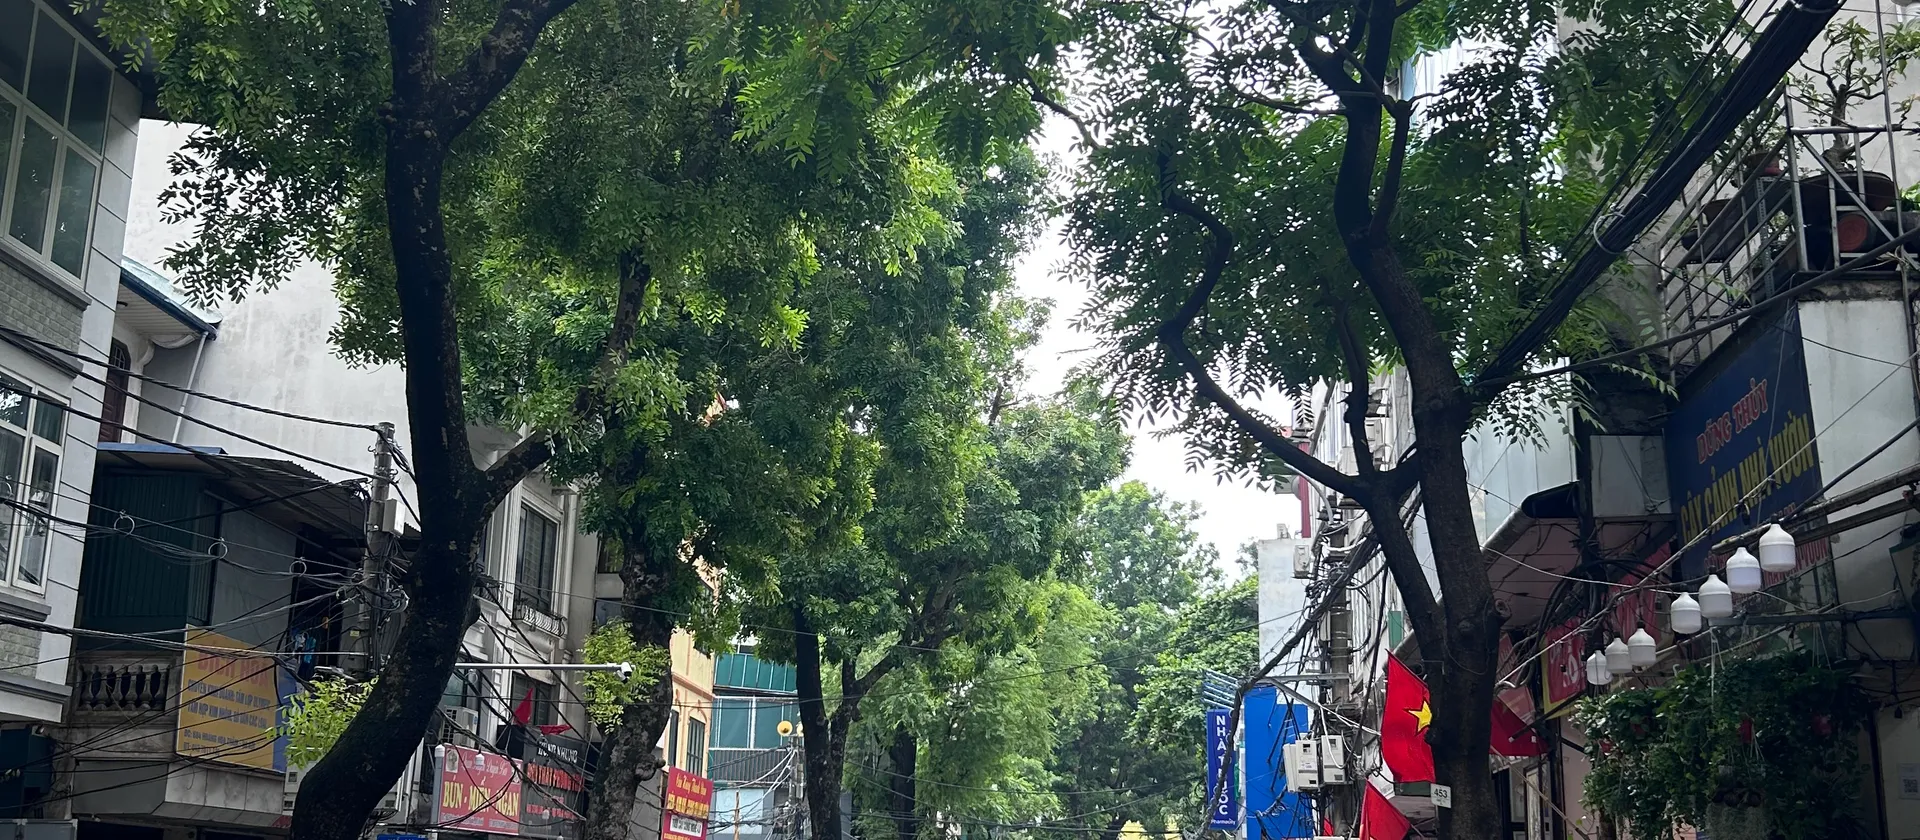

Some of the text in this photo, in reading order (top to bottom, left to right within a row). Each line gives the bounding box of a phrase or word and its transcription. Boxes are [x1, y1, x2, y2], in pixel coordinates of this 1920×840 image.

[1732, 377, 1768, 434] THỦY
[1681, 491, 1702, 544] CÂY
[1704, 466, 1739, 535] CẢNH
[1769, 410, 1814, 489] VƯỜN
[1216, 715, 1227, 751] NHÀ
[443, 775, 463, 808] BÚN
[1434, 788, 1448, 799] 453
